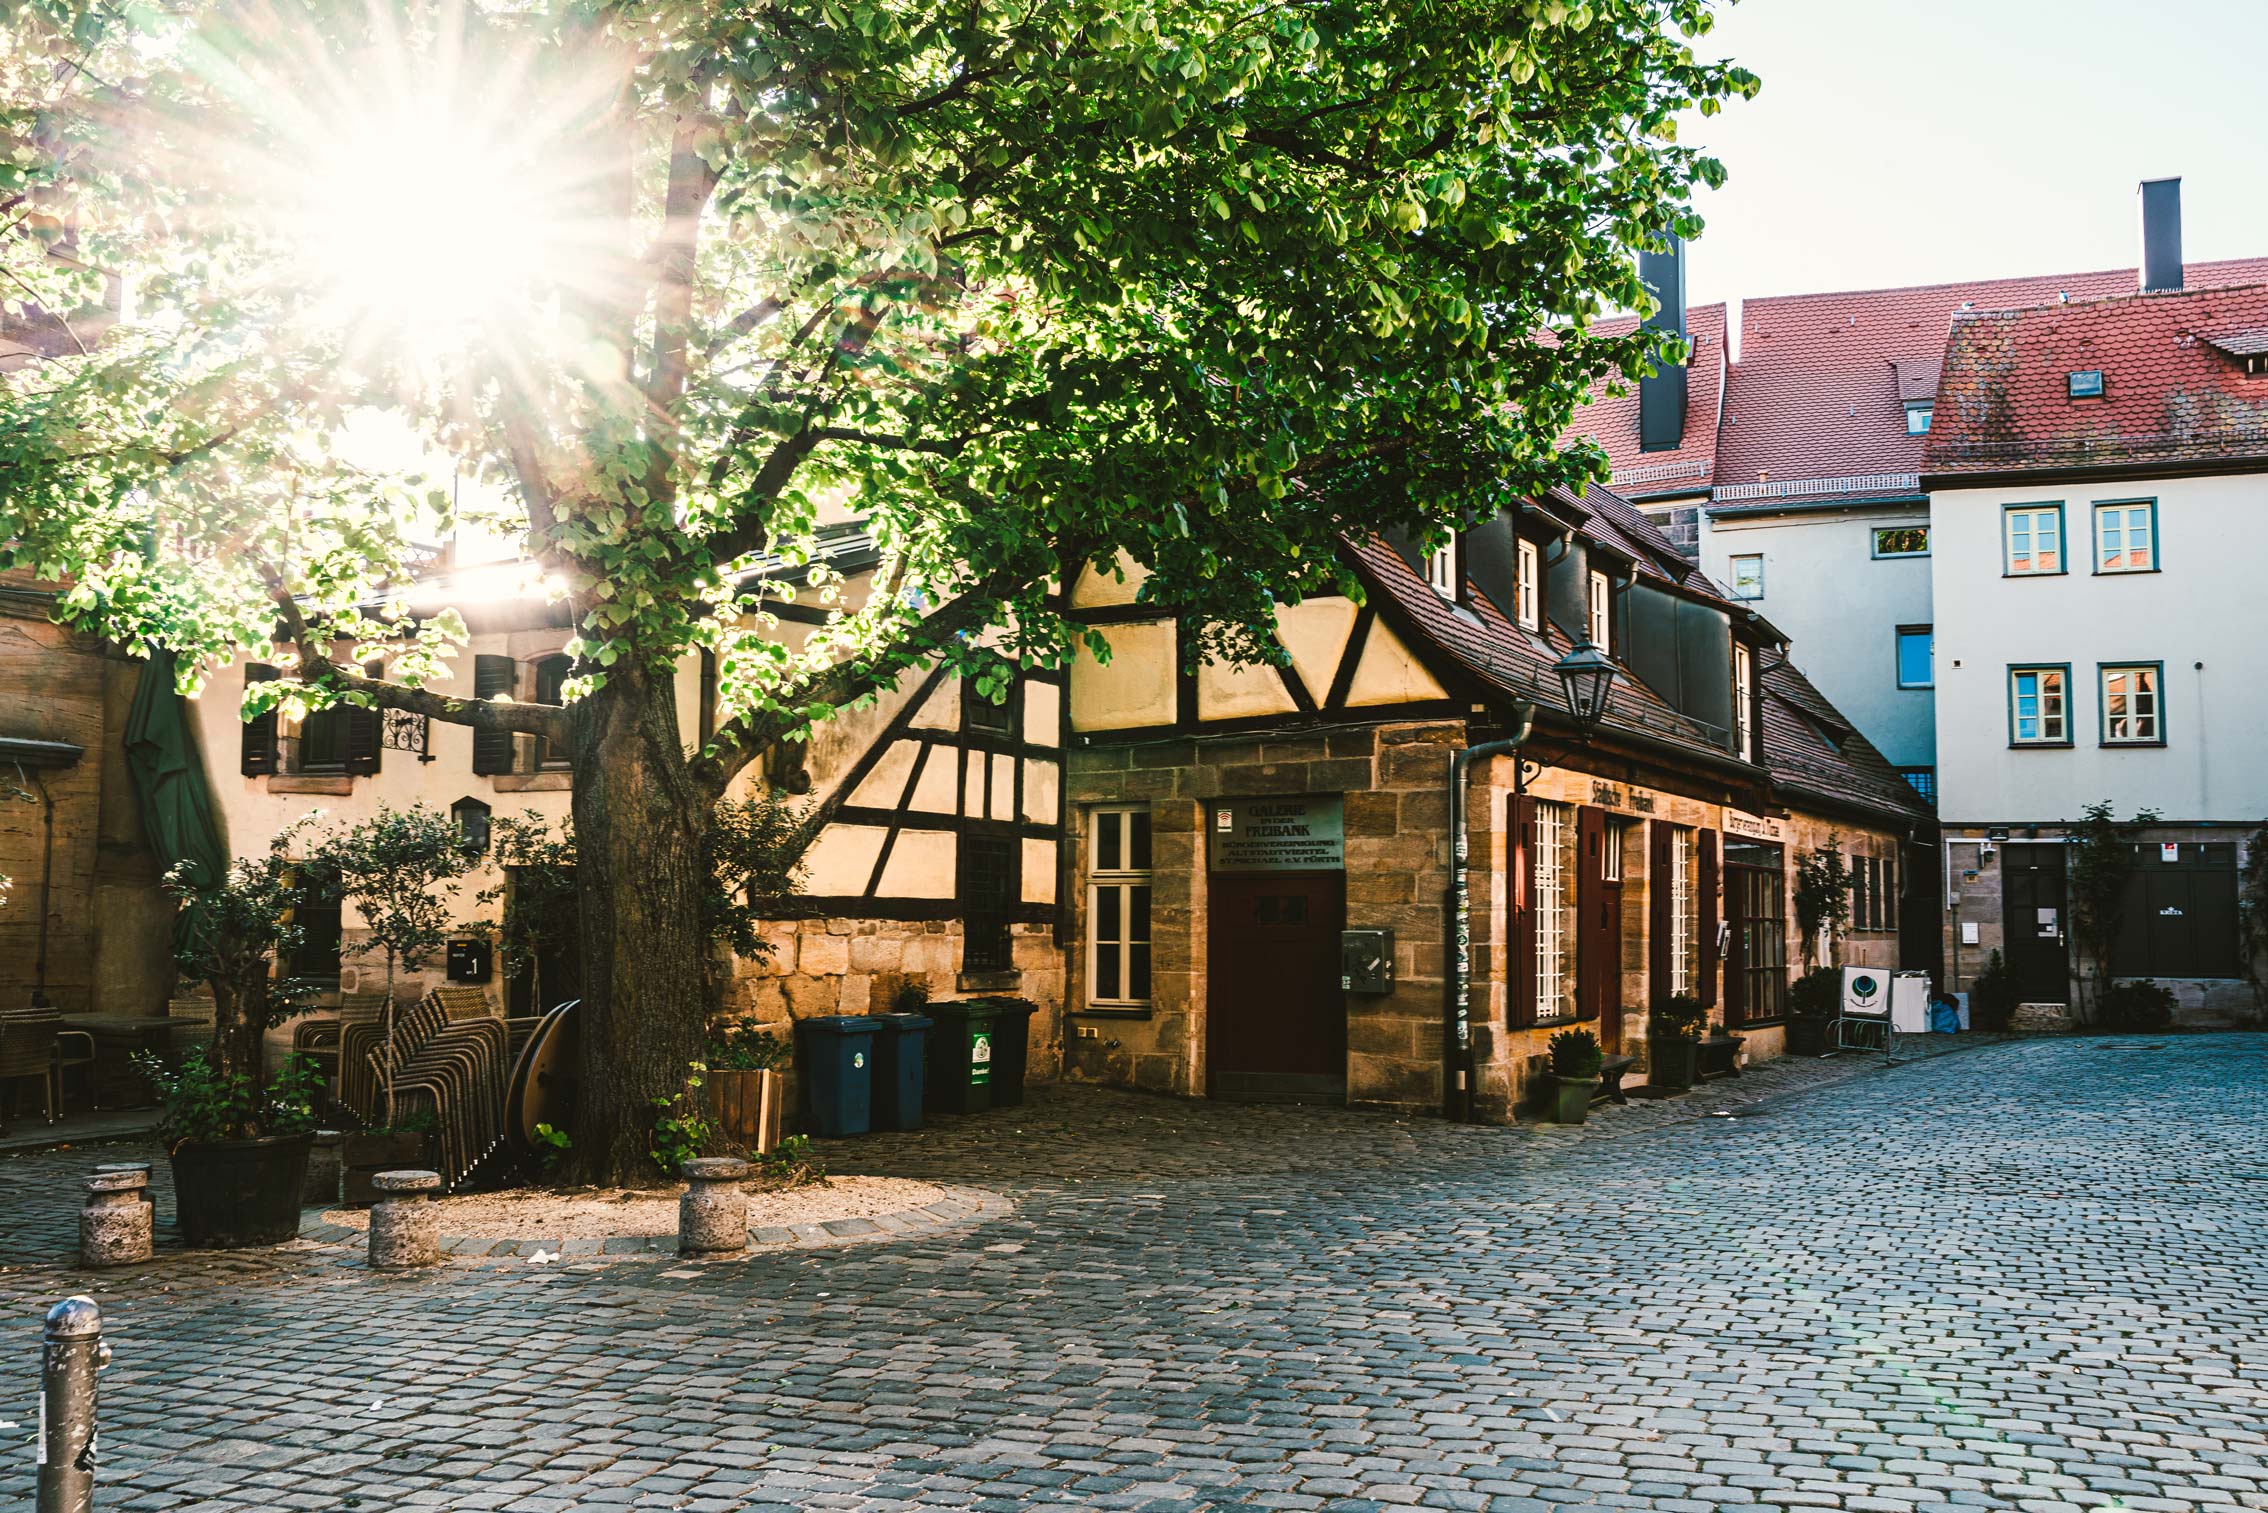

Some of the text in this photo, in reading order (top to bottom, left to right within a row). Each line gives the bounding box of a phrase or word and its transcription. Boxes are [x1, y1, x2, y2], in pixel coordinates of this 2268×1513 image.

[1249, 805, 1306, 816] GALERIE
[1246, 825, 1310, 837] FREIBANK
[1228, 849, 1329, 857] ALTSTADTVIERTEL
[472, 957, 477, 974] 1
